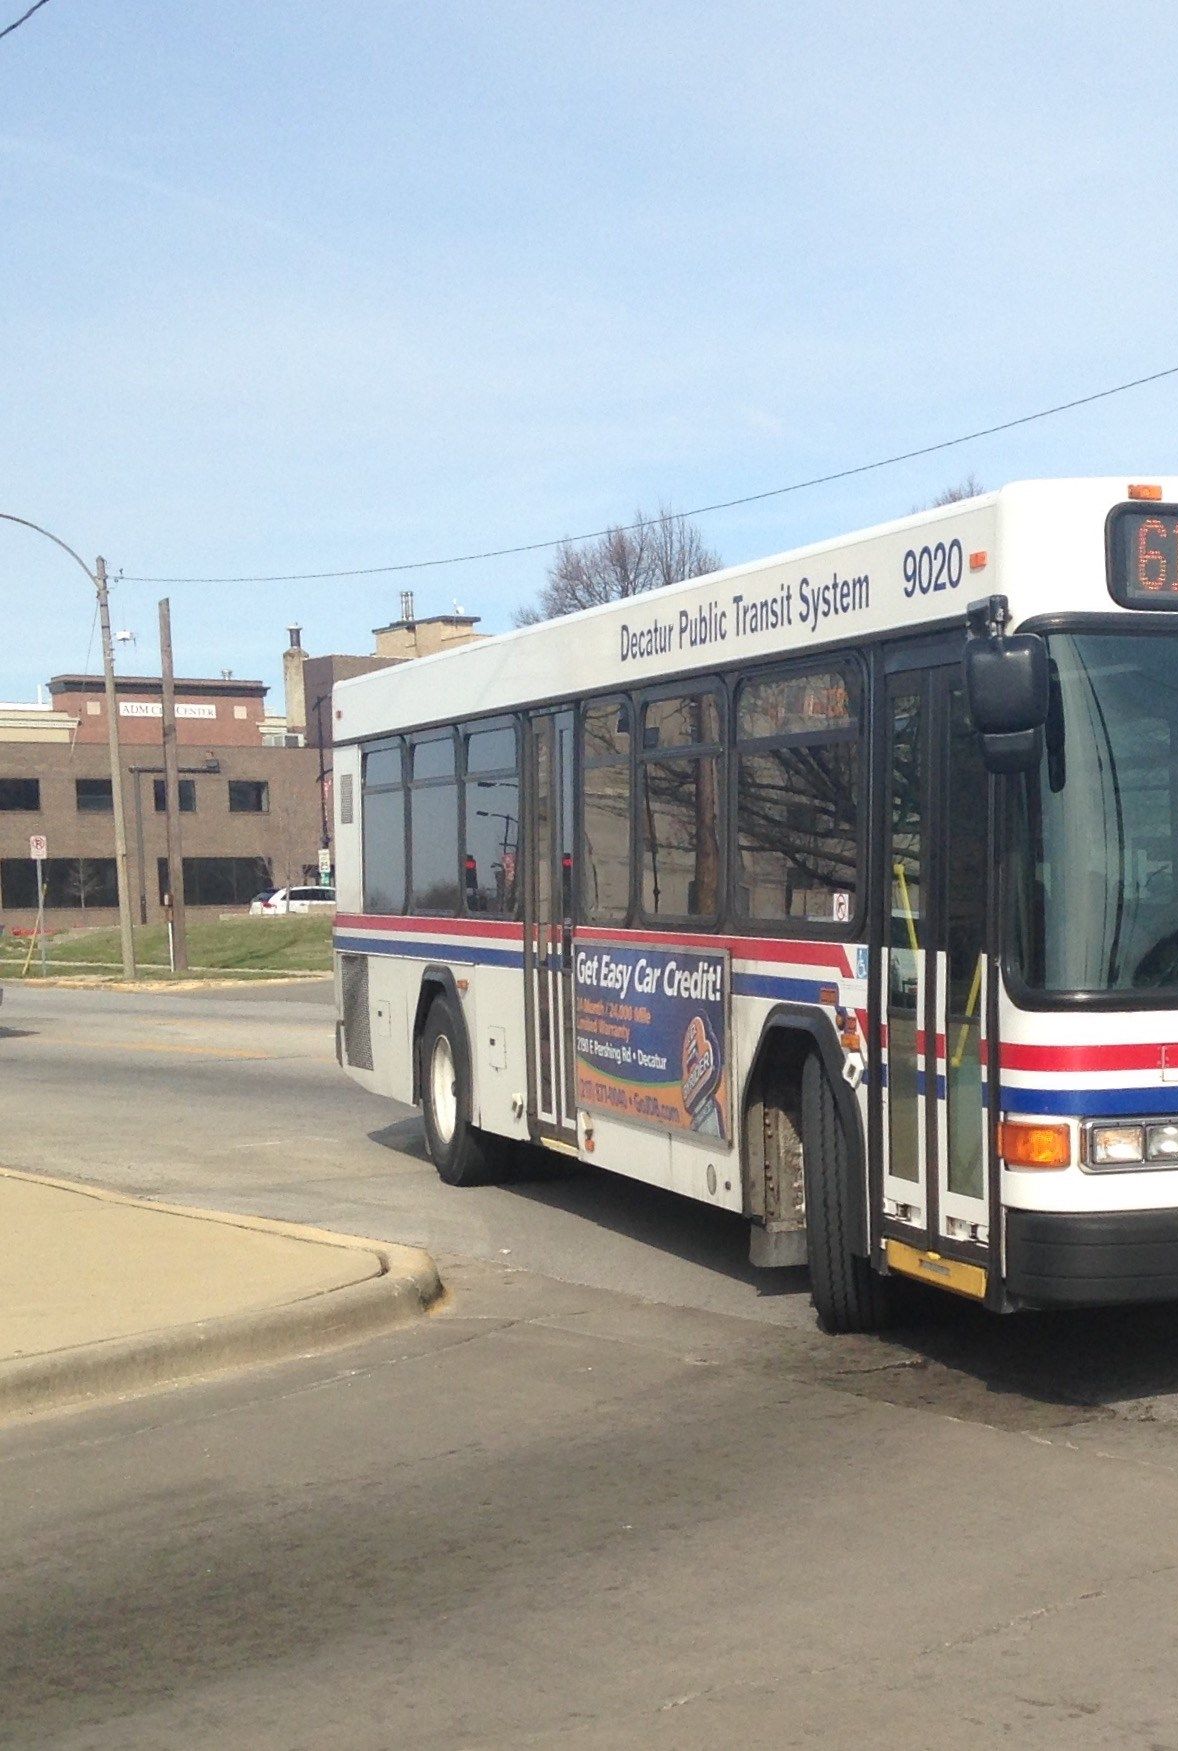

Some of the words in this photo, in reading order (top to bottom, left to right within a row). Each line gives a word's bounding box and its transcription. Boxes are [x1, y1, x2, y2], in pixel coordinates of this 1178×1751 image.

[903, 538, 963, 599] 9020
[620, 624, 673, 662] Decatur
[678, 604, 727, 650] Public
[733, 584, 792, 638] Transit
[799, 572, 870, 633] System
[576, 951, 599, 986] Get
[600, 954, 632, 999] Easy
[634, 958, 662, 994] Car
[663, 961, 722, 1001] Credit!
[637, 1049, 668, 1070] Decatur
